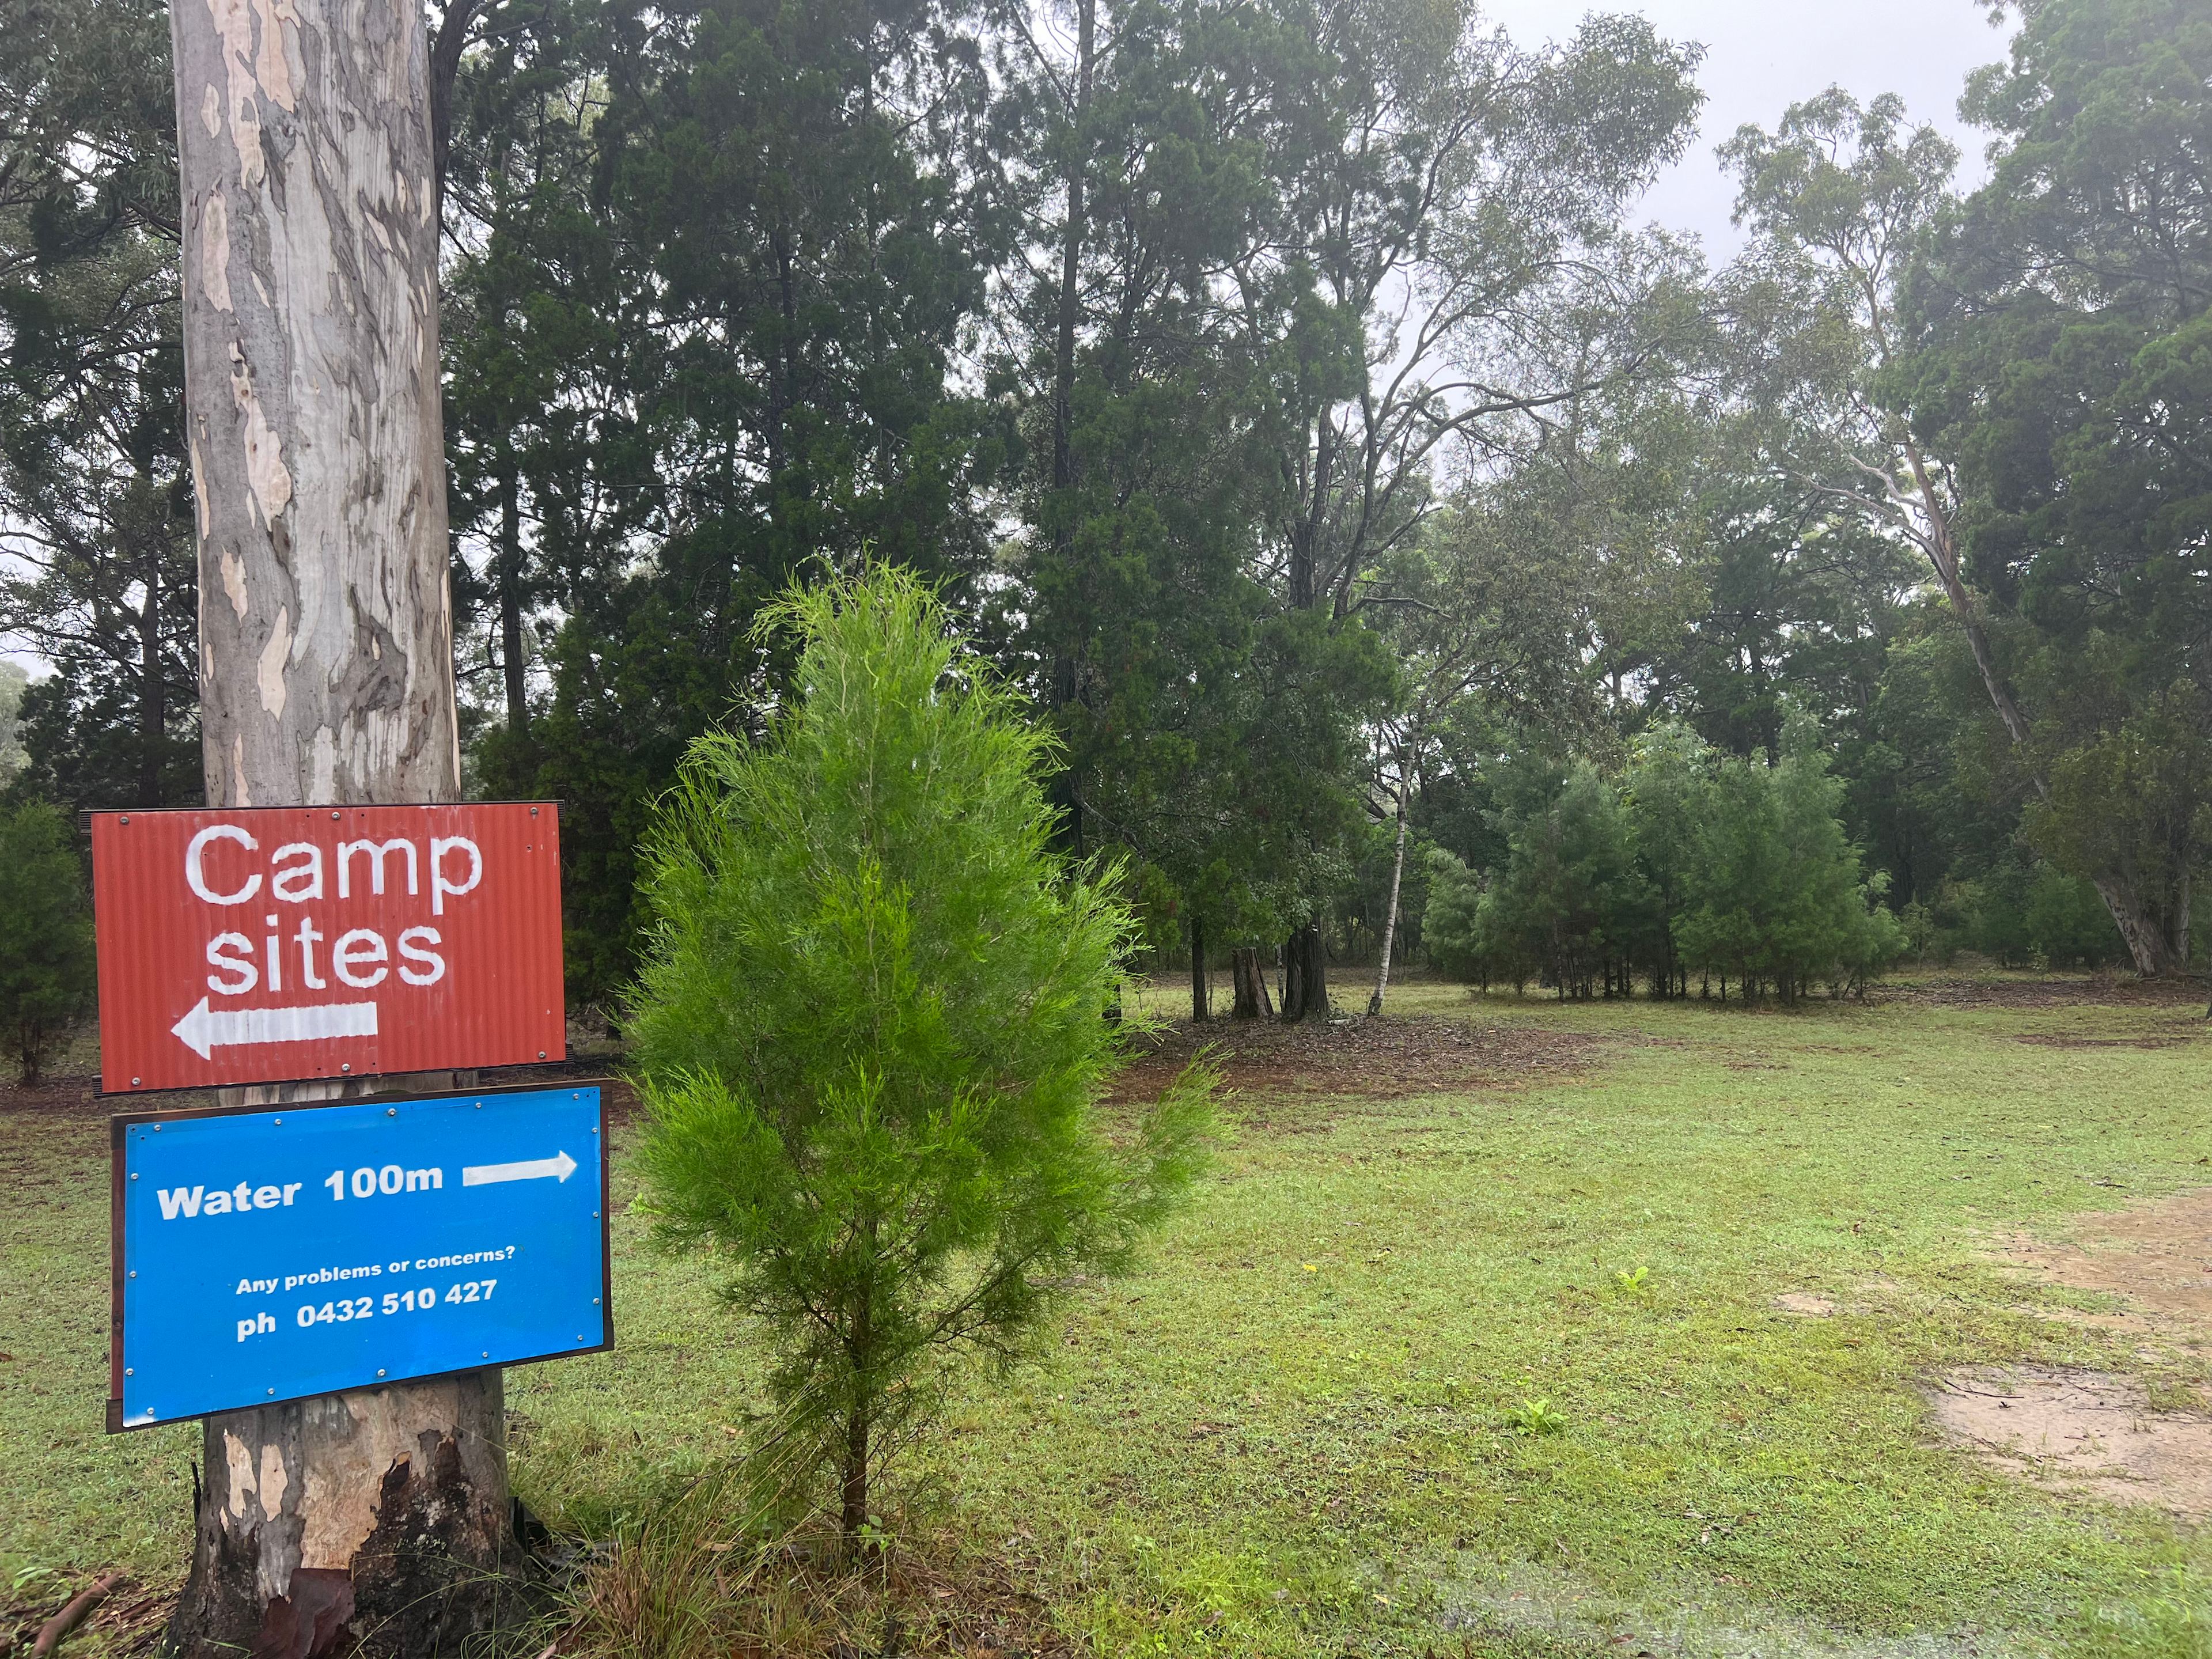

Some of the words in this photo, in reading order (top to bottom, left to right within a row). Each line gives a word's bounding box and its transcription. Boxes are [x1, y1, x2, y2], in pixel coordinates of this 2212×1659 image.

[186, 824, 482, 915] Camp
[207, 914, 445, 995] sites
[157, 1181, 302, 1219] Water
[325, 1165, 442, 1200] 100m
[236, 1279, 278, 1294] Any
[286, 1265, 381, 1290] problems
[389, 1261, 410, 1272] or
[416, 1246, 515, 1269] concerns?
[238, 1313, 275, 1342] ph
[298, 1297, 373, 1327] 0432
[382, 1288, 435, 1314] 510
[445, 1279, 497, 1304] 427
